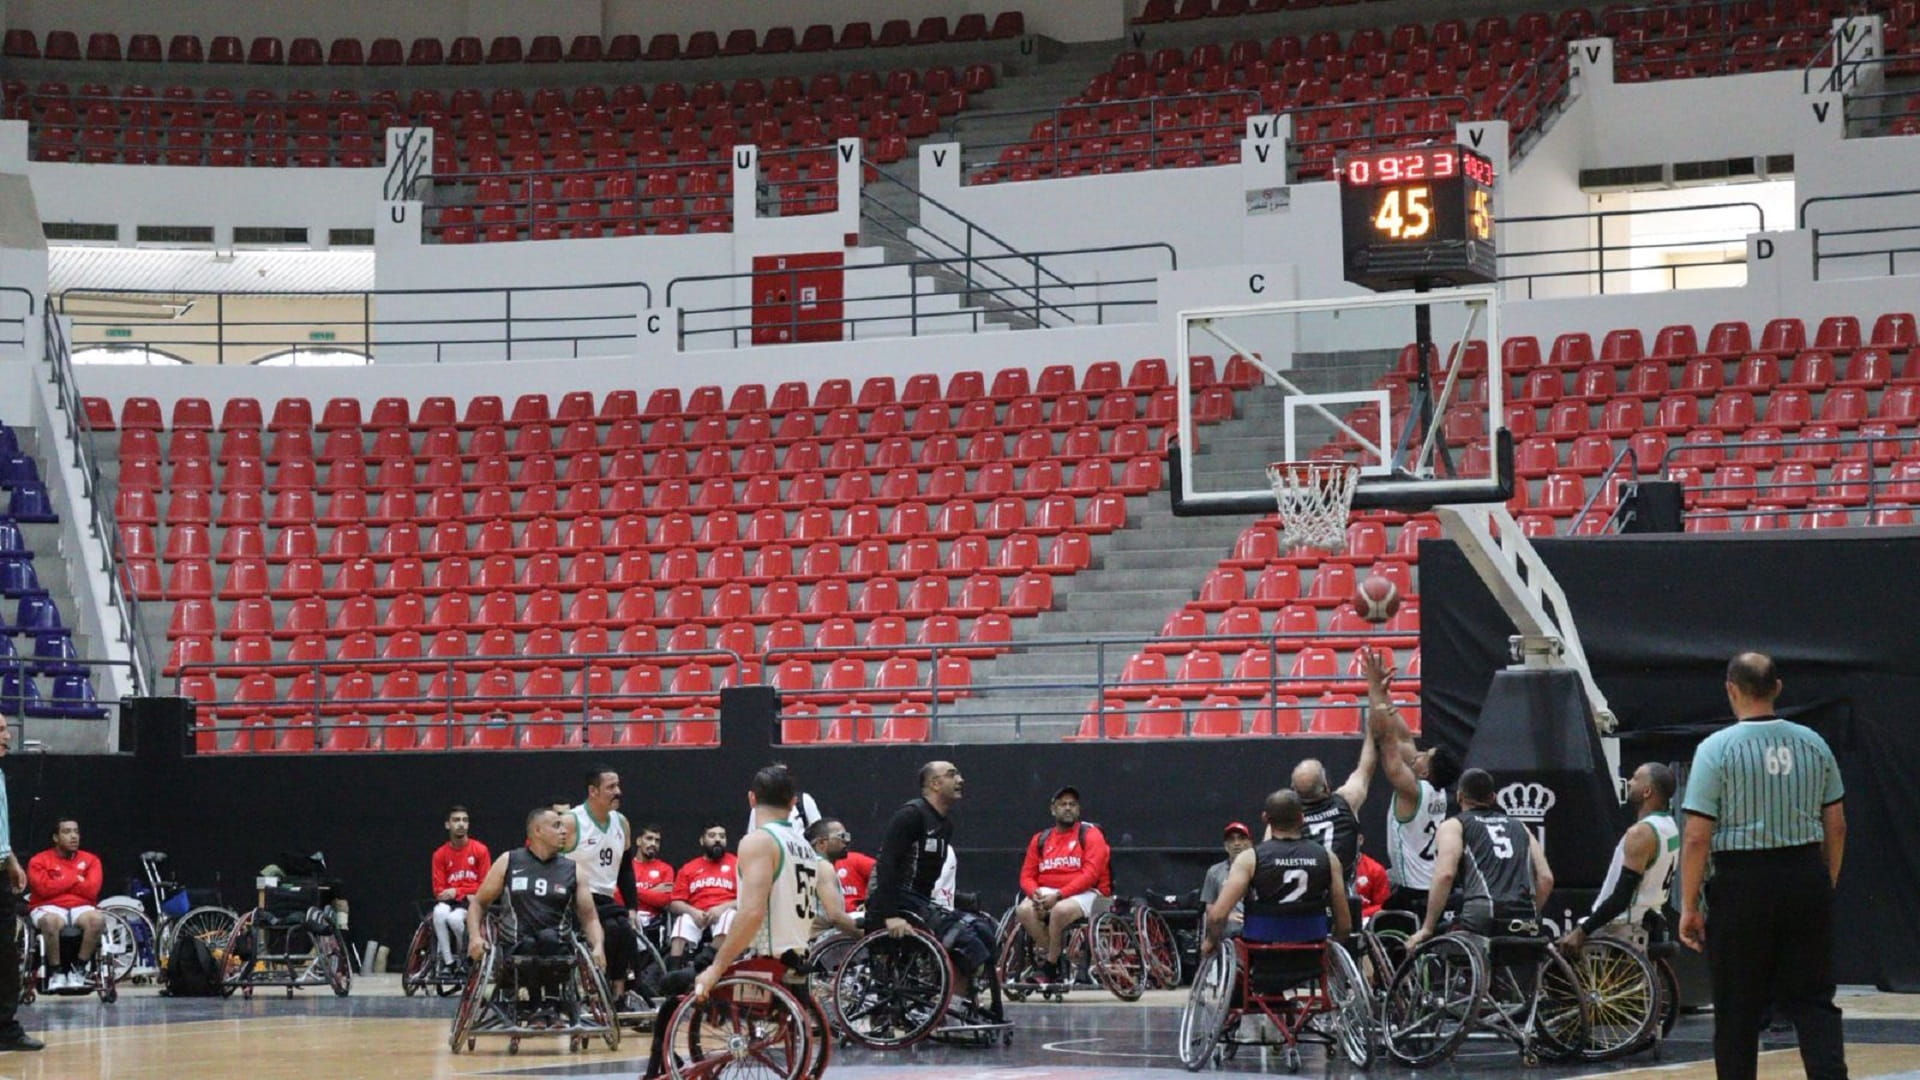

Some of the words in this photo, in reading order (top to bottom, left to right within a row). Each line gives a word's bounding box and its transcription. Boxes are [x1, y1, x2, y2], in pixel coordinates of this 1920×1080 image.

[1586, 46, 1601, 64] V
[1812, 102, 1829, 123] V
[1254, 122, 1268, 138] V
[1470, 128, 1484, 147] V
[737, 151, 751, 169] U
[840, 145, 854, 163] V
[933, 150, 947, 168] V
[1255, 144, 1270, 163] V
[391, 205, 405, 223] U
[1375, 187, 1430, 239] 45
[1757, 239, 1775, 260] D
[1249, 273, 1265, 294] C
[647, 315, 661, 334] C
[1765, 746, 1793, 775] 69
[1309, 821, 1334, 851] 7
[1485, 823, 1514, 860] 5
[599, 847, 613, 867] 99
[1275, 857, 1318, 867] PALESTINE
[534, 878, 548, 896] 9
[689, 875, 734, 894] BAHRAIN
[1279, 868, 1309, 905] 2
